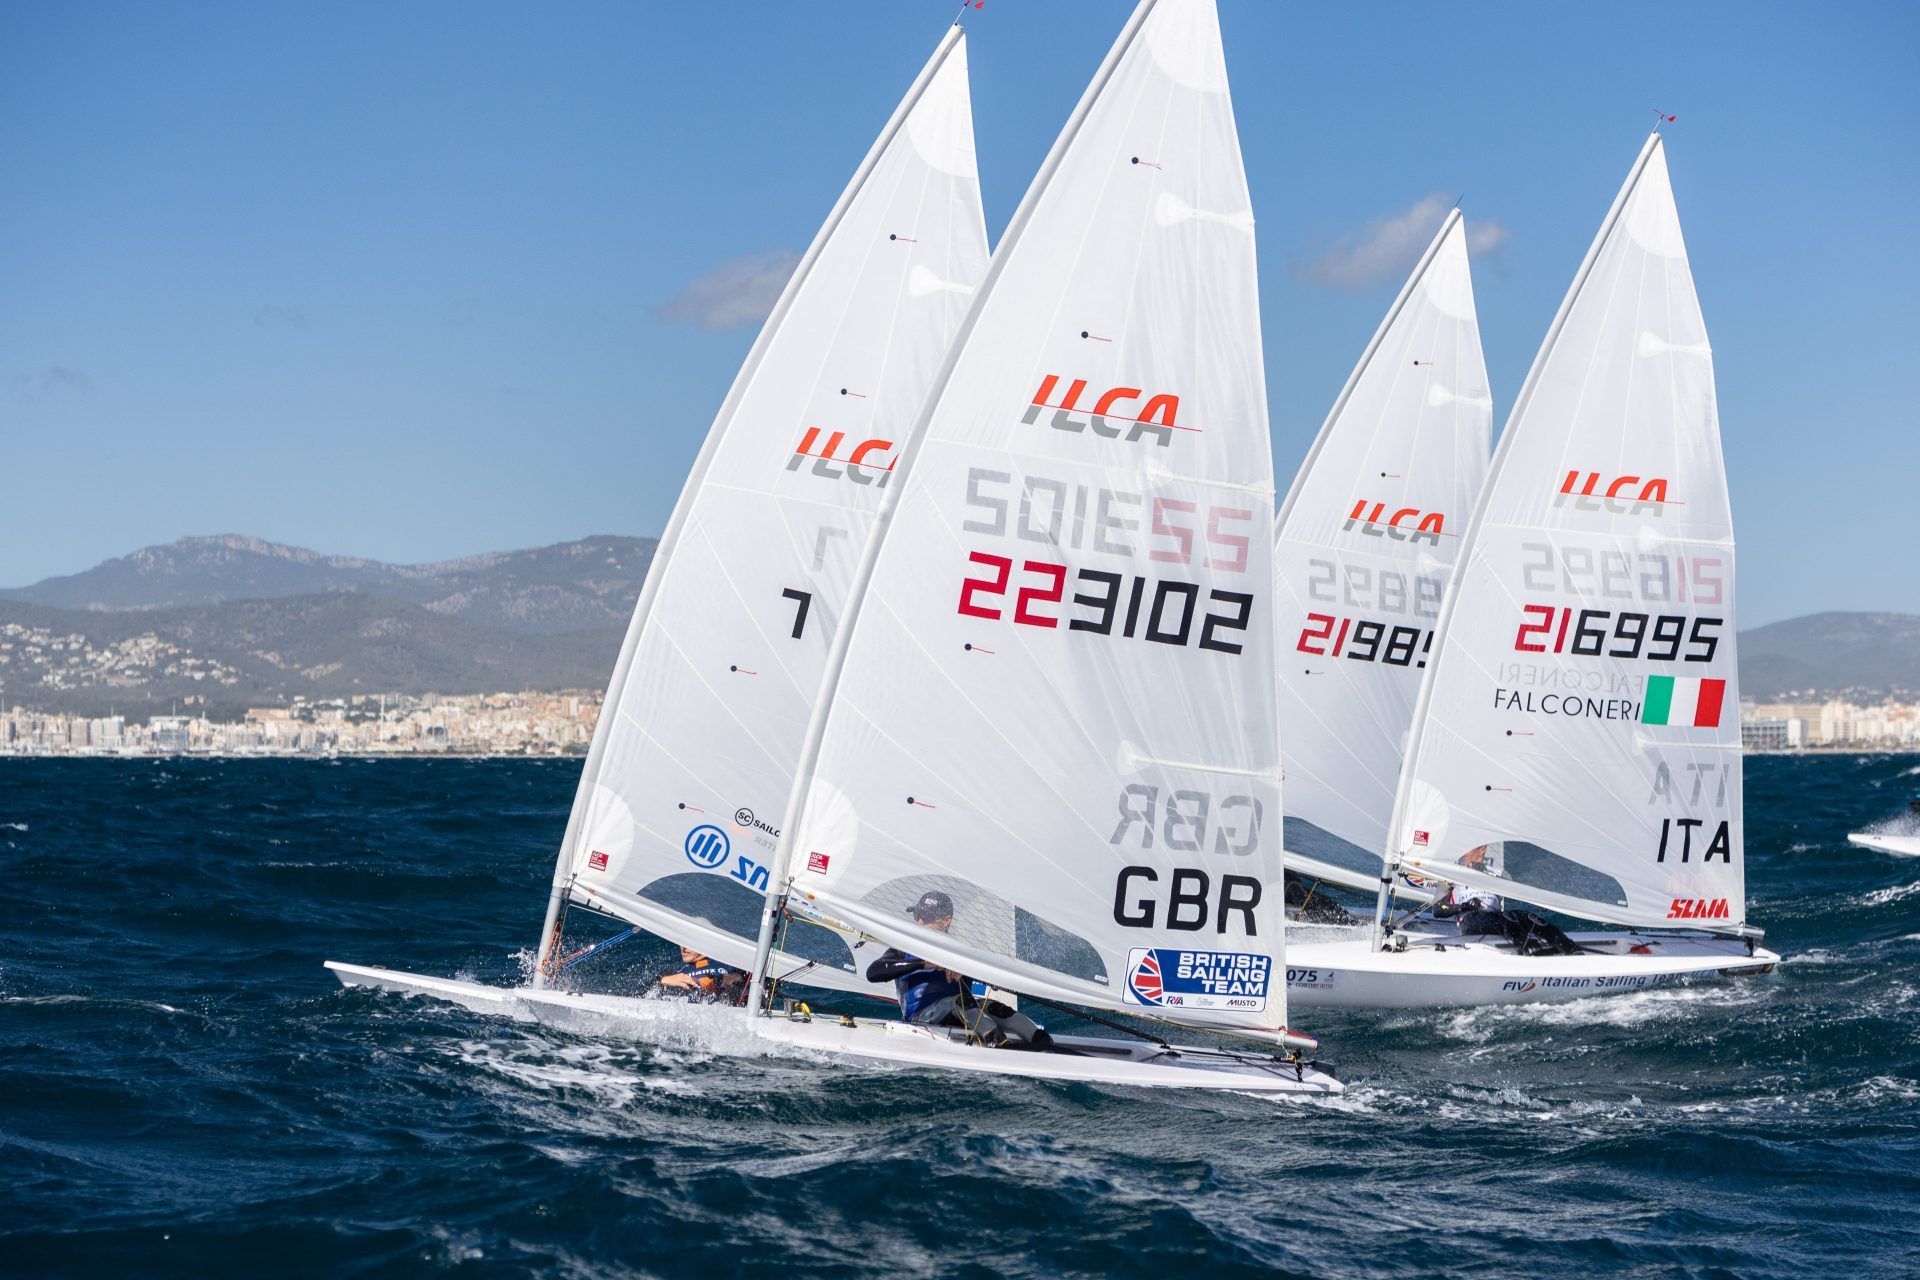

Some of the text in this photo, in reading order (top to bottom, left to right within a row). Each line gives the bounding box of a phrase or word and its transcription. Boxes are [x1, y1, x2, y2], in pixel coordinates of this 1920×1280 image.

[1021, 374, 1180, 447] ILCA
[1553, 470, 1668, 518] ILCA
[1342, 499, 1445, 547] ILCA
[782, 587, 812, 640] 7
[957, 550, 1254, 656] 223102
[1514, 604, 1724, 663] 216995
[1494, 688, 1641, 721] FALCONERI
[738, 812, 752, 823] SC
[1657, 818, 1731, 864] ITA
[1113, 865, 1262, 936] GBR
[1667, 898, 1729, 919] SLAM
[1177, 966, 1266, 982] SAILING
[1179, 952, 1267, 970] BRITISH
[1201, 980, 1263, 995] TEAM
[1503, 981, 1527, 991] FIV
[1541, 976, 1590, 988] Italian
[1595, 975, 1647, 988] Sailing
[1166, 996, 1183, 1005] RYA
[1226, 999, 1257, 1007] MUSTO
